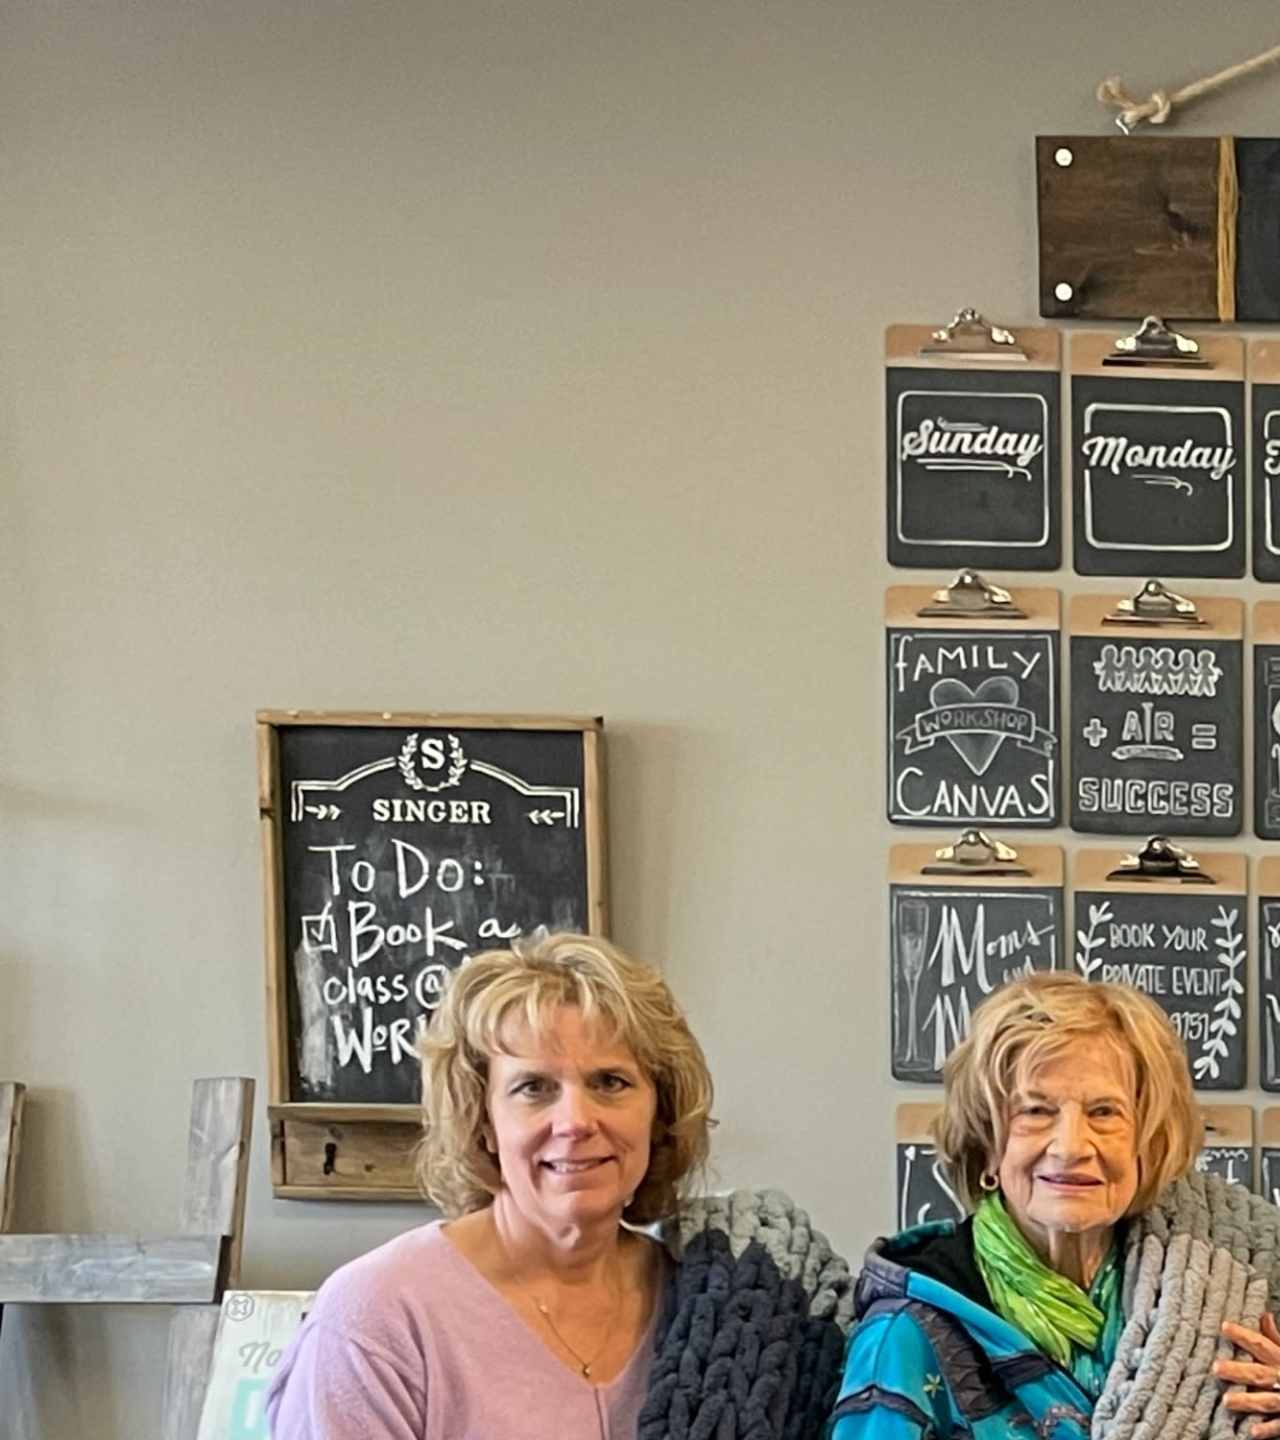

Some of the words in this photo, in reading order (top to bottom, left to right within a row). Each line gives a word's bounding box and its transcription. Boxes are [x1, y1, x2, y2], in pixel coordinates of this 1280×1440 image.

[901, 418, 1044, 459] Sunday
[1082, 436, 1237, 481] Monday
[921, 707, 1029, 733] WORKSHOP
[372, 798, 492, 825] SINGER
[1078, 776, 1235, 818] SUCCESS
[307, 843, 377, 896] To
[391, 837, 486, 899] Do:
[346, 899, 468, 968] Book
[927, 903, 1056, 995] Moms
[1109, 922, 1156, 950] BOOK
[1161, 925, 1209, 952] YOUR
[322, 965, 409, 1005] class
[1101, 963, 1165, 996] PRIVATE
[1171, 965, 1228, 998] EVENT
